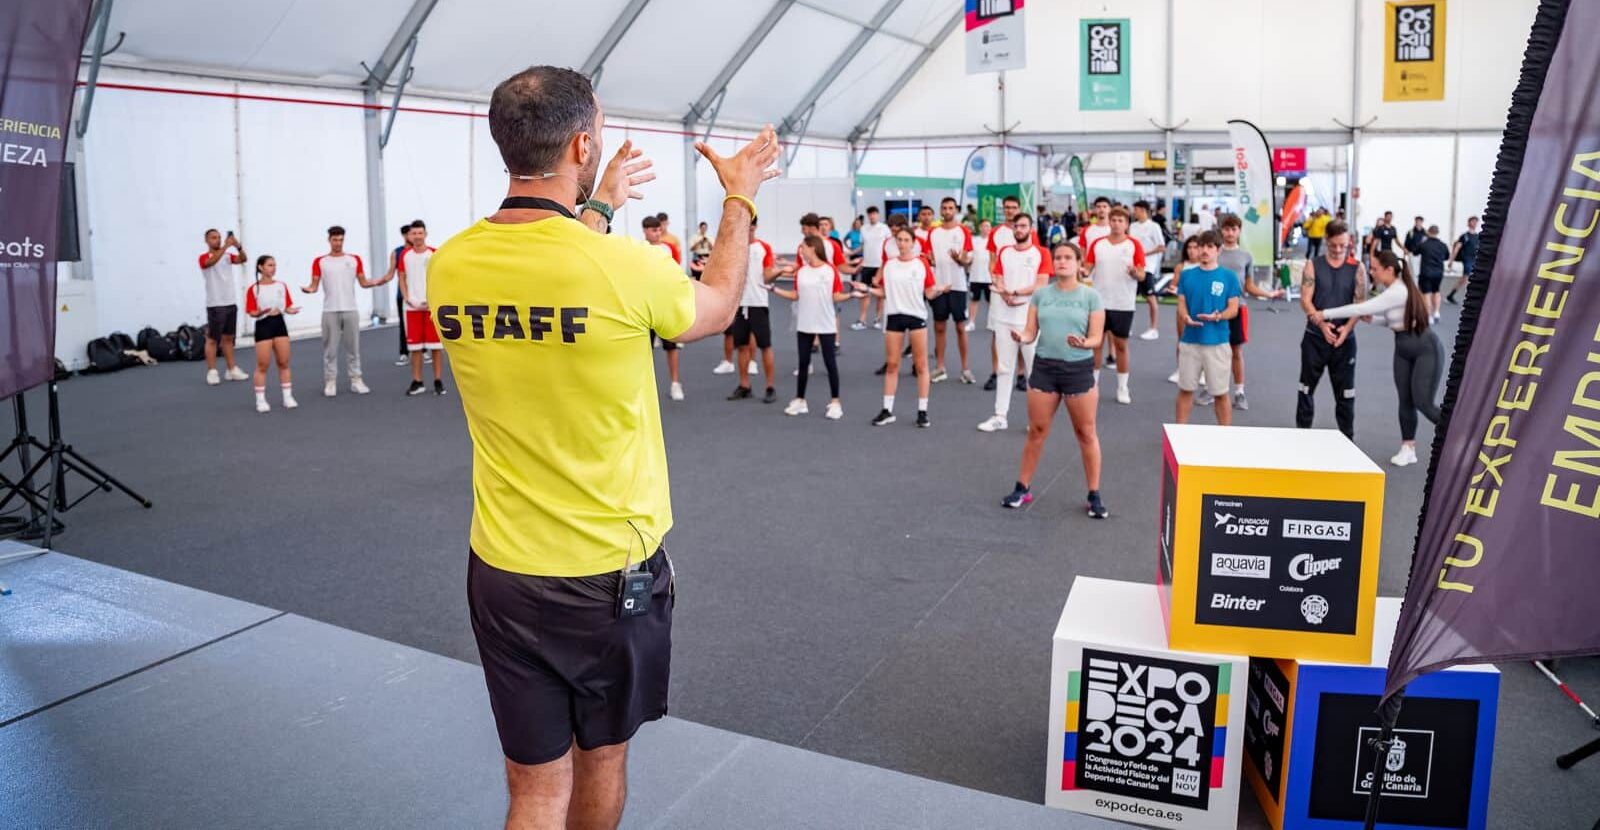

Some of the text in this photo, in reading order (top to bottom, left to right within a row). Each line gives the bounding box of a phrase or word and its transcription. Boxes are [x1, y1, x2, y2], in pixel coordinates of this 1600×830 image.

[437, 305, 588, 343] STAFF
[1463, 151, 1600, 518] EXPERIENCIA
[1216, 557, 1266, 571] aquavia
[1288, 553, 1343, 581] Clipper
[1210, 593, 1266, 611] Binter
[1088, 658, 1211, 705] EXPO
[1086, 689, 1205, 737] DECA
[1085, 721, 1201, 767] 2024
[1084, 762, 1092, 770] la
[1093, 764, 1128, 777] Actividad
[1151, 775, 1157, 783] y
[1157, 775, 1170, 783] del
[1089, 755, 1122, 766] Congreso
[1129, 761, 1148, 771] Feria
[1148, 764, 1159, 773] de
[1084, 772, 1160, 790] Deporte de Canarias
[1174, 781, 1197, 791] NOV
[1175, 773, 1198, 783] 14/17
[1385, 781, 1422, 791] Canaria
[1404, 774, 1416, 783] de
[1095, 798, 1183, 821] expodeca.es
